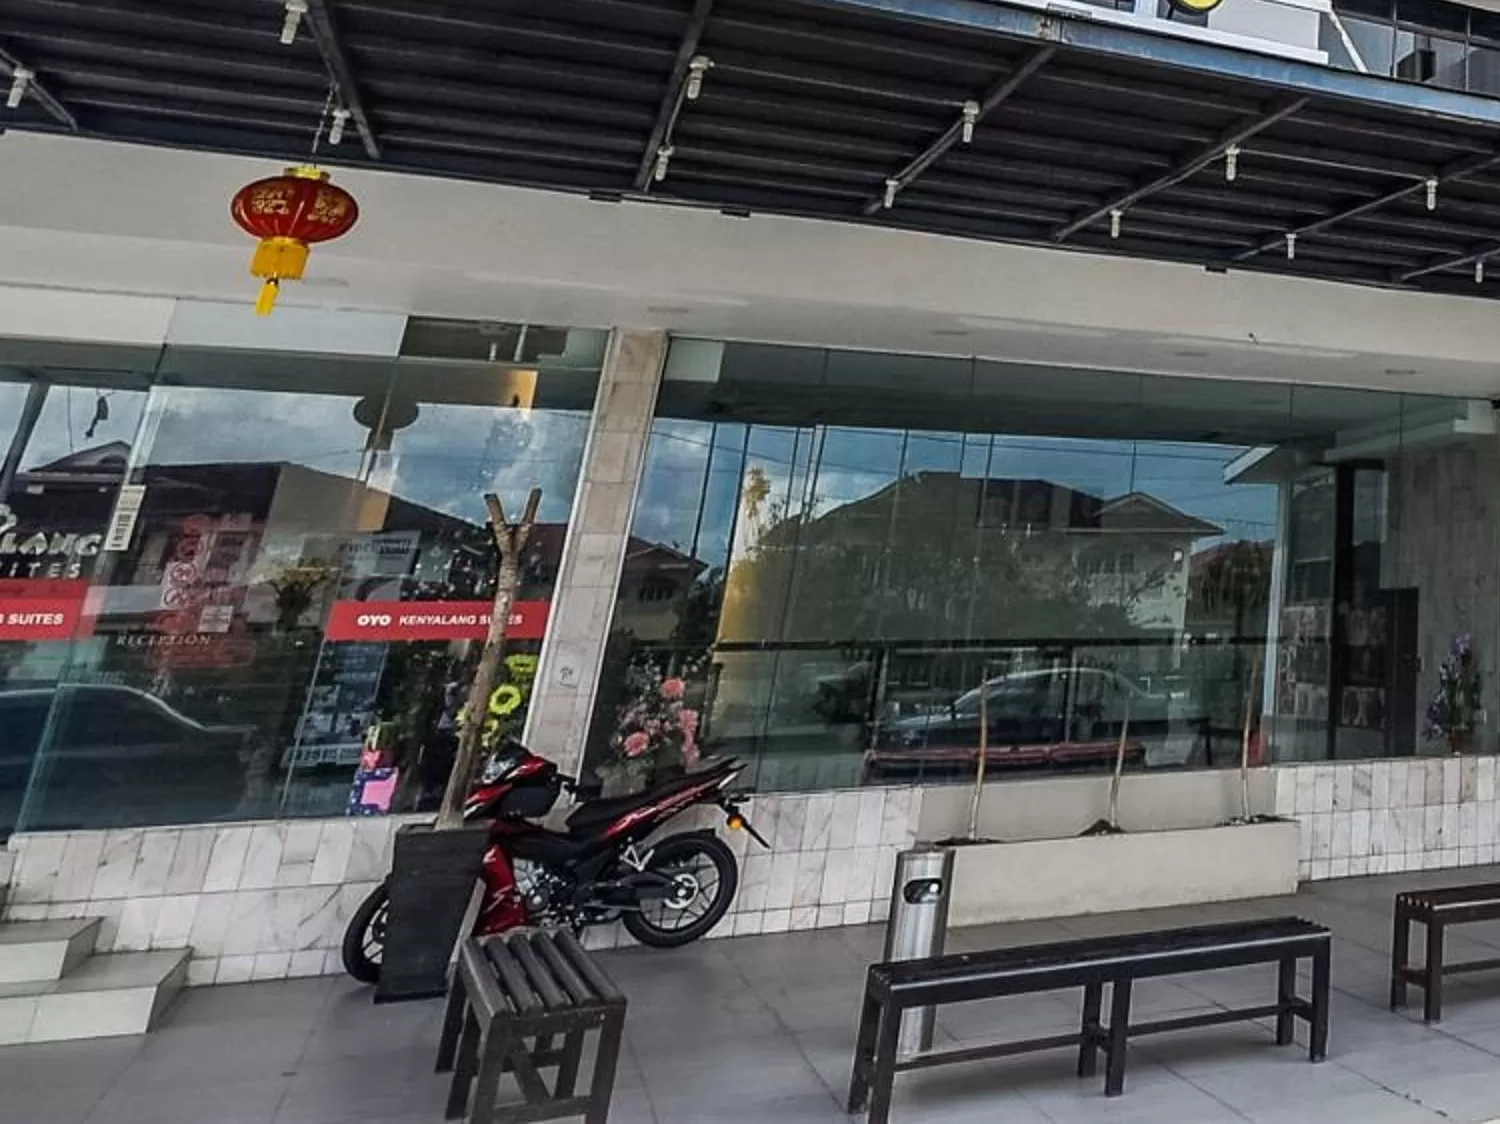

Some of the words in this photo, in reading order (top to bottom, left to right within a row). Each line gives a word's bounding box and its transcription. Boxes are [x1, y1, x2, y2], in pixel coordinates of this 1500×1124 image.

[0, 561, 82, 579] ITES
[7, 613, 64, 625] SUITES
[357, 614, 392, 626] OYO
[399, 614, 477, 625] KENYALANG
